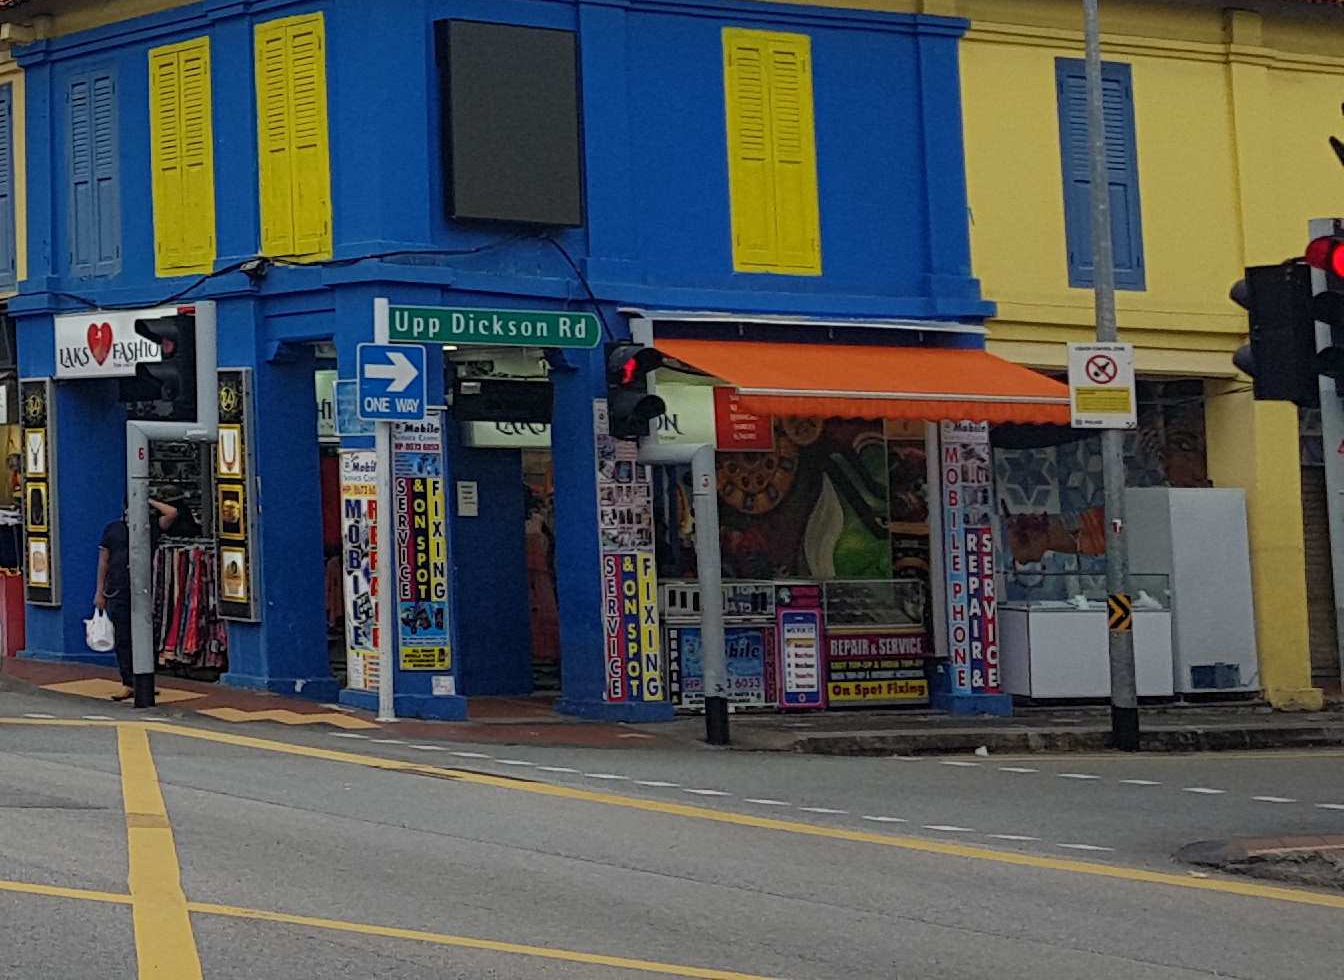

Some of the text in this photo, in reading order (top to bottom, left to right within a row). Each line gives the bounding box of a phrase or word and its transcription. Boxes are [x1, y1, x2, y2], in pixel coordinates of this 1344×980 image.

[59, 346, 90, 369] LAKS
[112, 339, 160, 362] FASHIO
[394, 310, 587, 340] Upp Dickson Rd
[364, 396, 420, 413] ONE WAY
[404, 423, 441, 434] Mobile
[344, 498, 362, 647] MOBILE
[396, 478, 412, 600] SERVICE
[416, 535, 428, 599] SPOT
[431, 480, 446, 600] FIXING
[944, 447, 967, 688] MOBILE PHONE
[604, 556, 623, 699] SERVICE
[642, 557, 660, 697] FIXING
[966, 533, 982, 660] REPAIR
[981, 533, 1000, 687] SERVICE
[627, 623, 641, 697] SPOT
[730, 641, 760, 658] bile
[830, 639, 870, 656] REPAIR
[879, 637, 924, 655] SERVICE
[832, 681, 925, 698] On Spot Fixing
